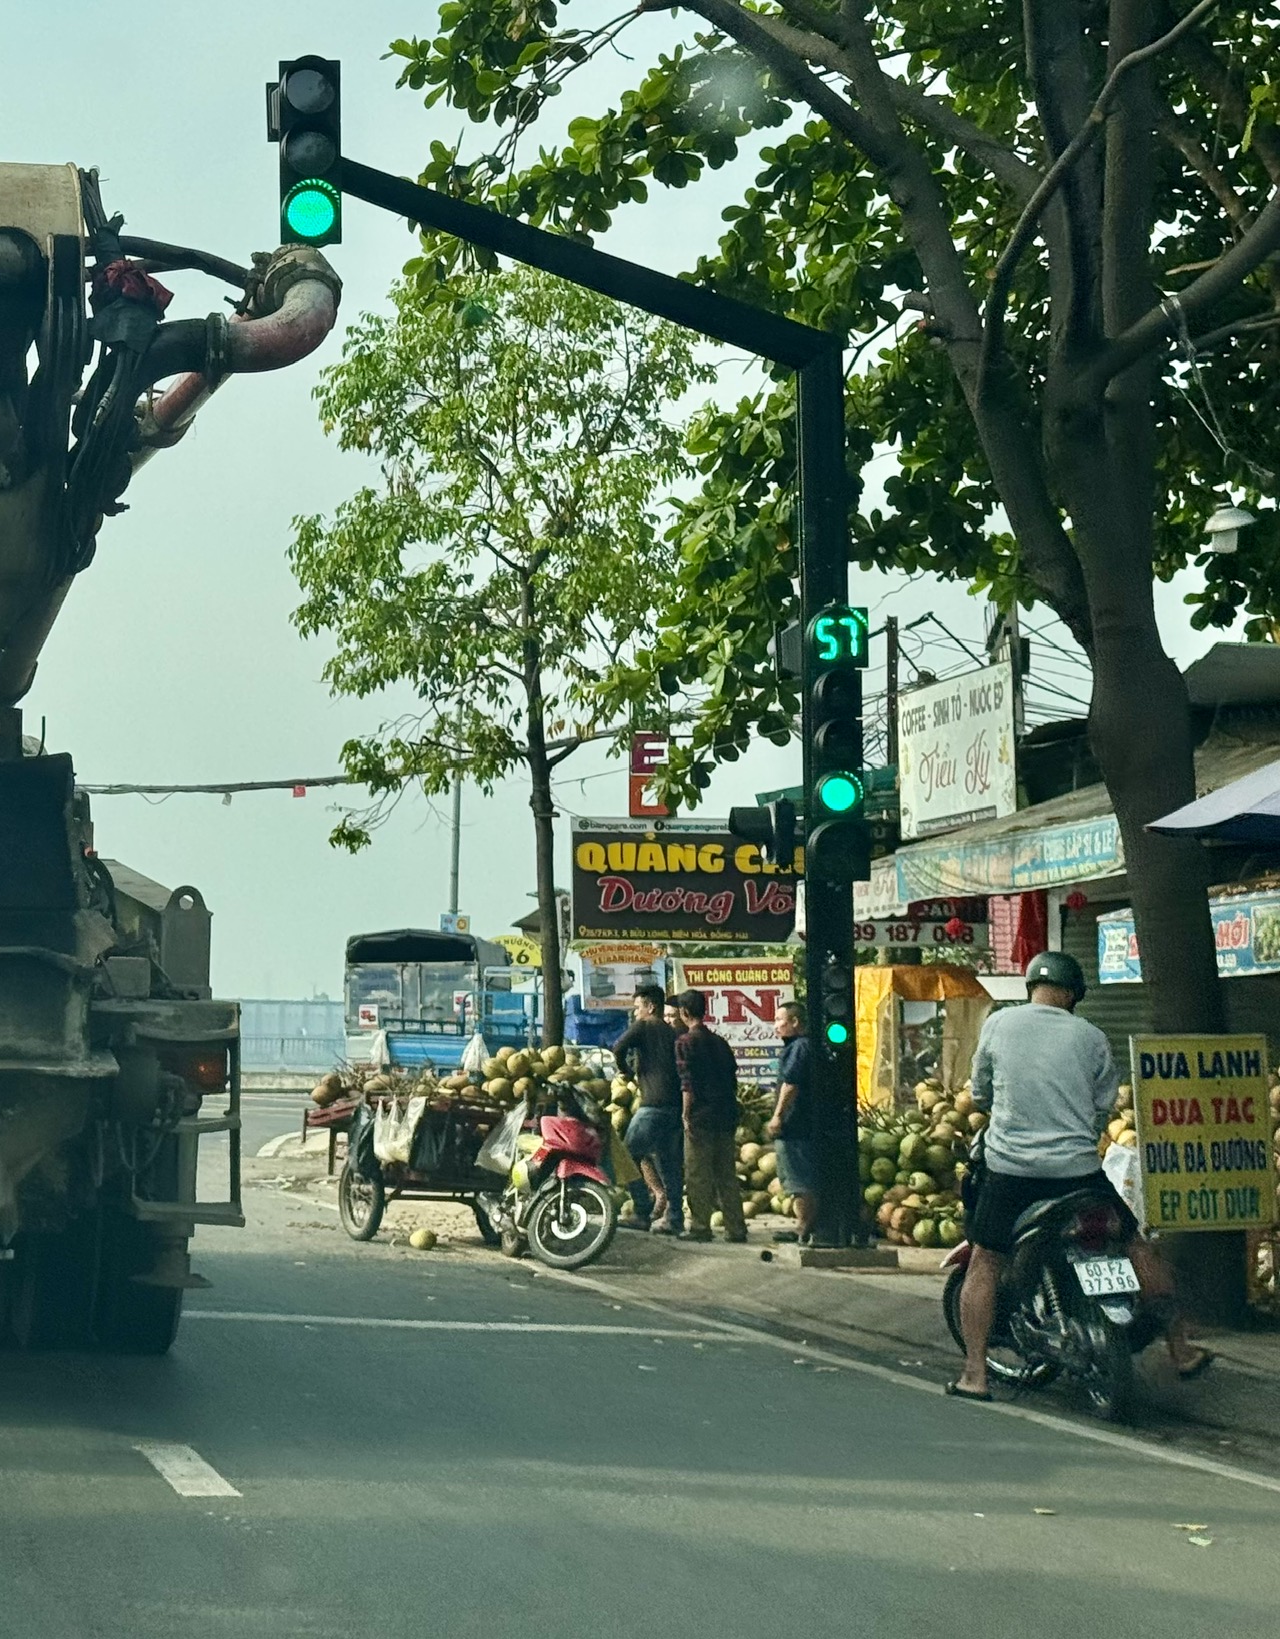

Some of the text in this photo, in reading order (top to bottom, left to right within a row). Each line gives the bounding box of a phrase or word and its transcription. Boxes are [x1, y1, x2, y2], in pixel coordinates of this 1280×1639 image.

[815, 616, 858, 660] 57
[901, 704, 926, 738] COFFEE
[576, 831, 725, 874] QUẢNG
[597, 876, 795, 924] Dương Võ
[885, 922, 920, 942] 187
[687, 970, 704, 982] THI
[703, 989, 781, 1023] IN
